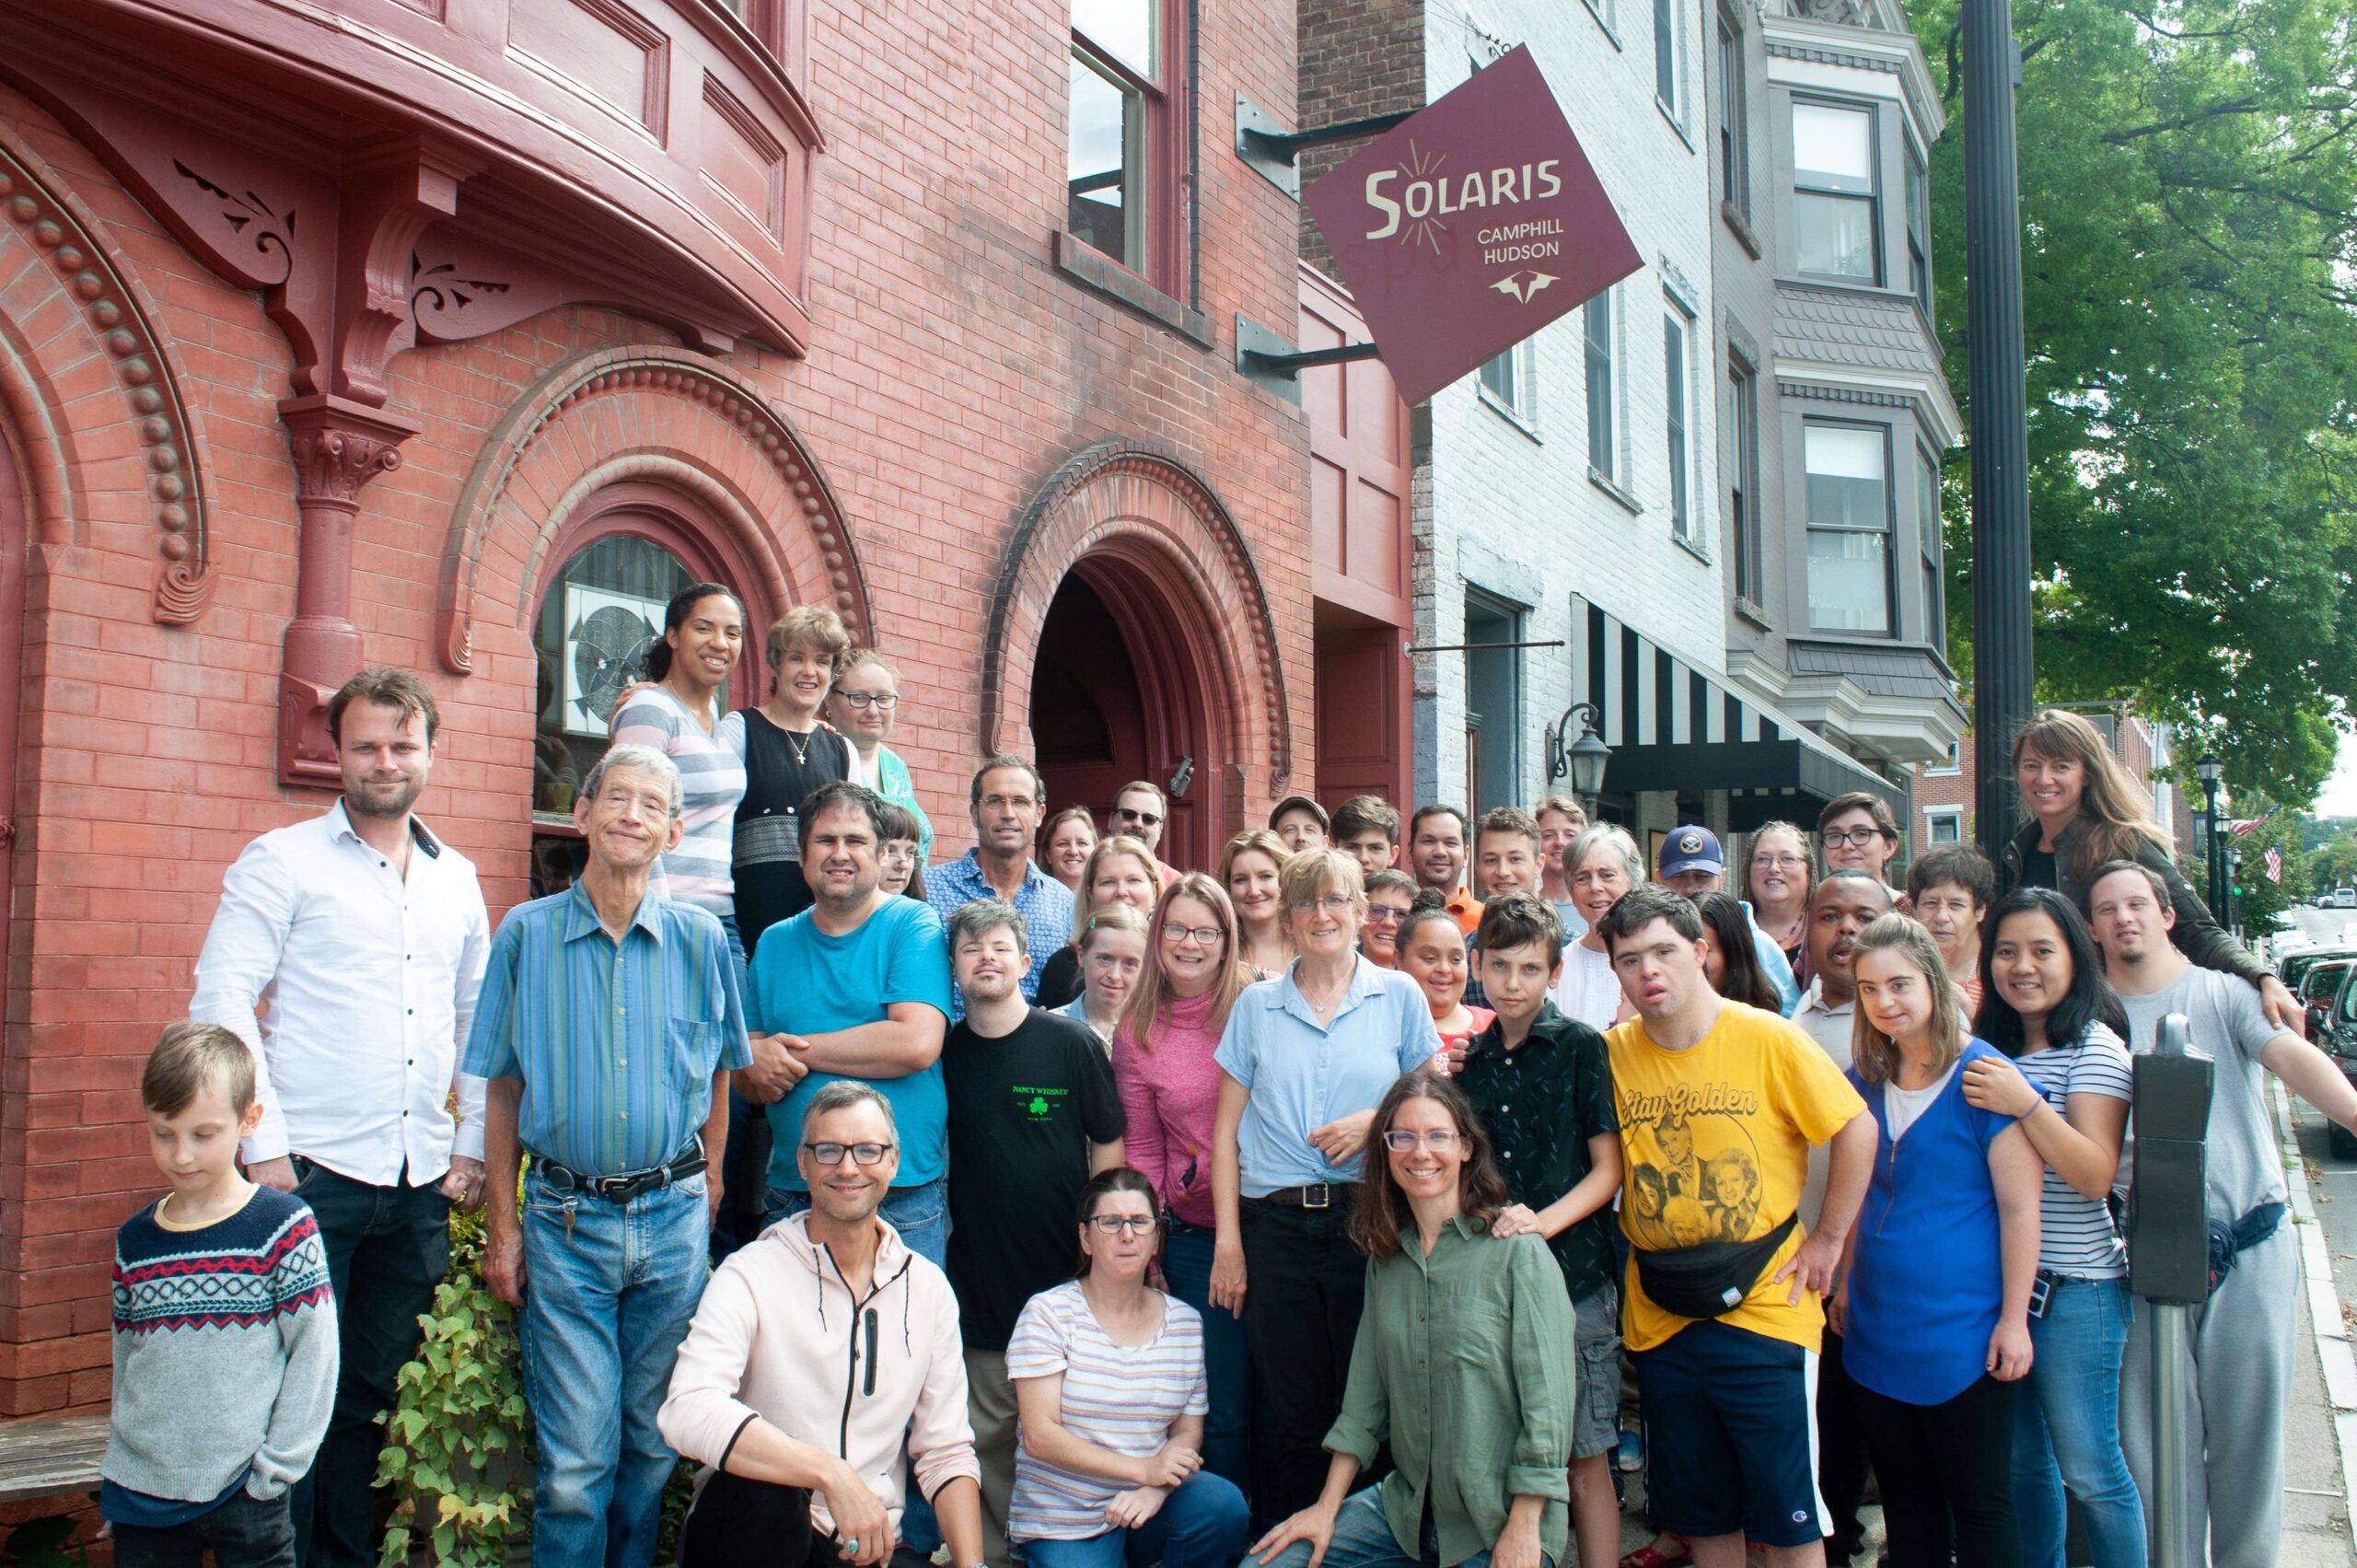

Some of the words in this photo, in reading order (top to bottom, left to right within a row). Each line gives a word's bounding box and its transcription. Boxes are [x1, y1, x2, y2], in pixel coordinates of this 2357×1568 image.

[1365, 159, 1562, 240] SOLARIS
[1477, 218, 1564, 245] CAMPHILL
[1484, 240, 1560, 265] HUDSON
[1013, 1086, 1035, 1095] NANCY
[1037, 1087, 1069, 1096] WHISKEY
[1620, 1089, 1667, 1131] Stay
[1666, 1083, 1758, 1131] Golden
